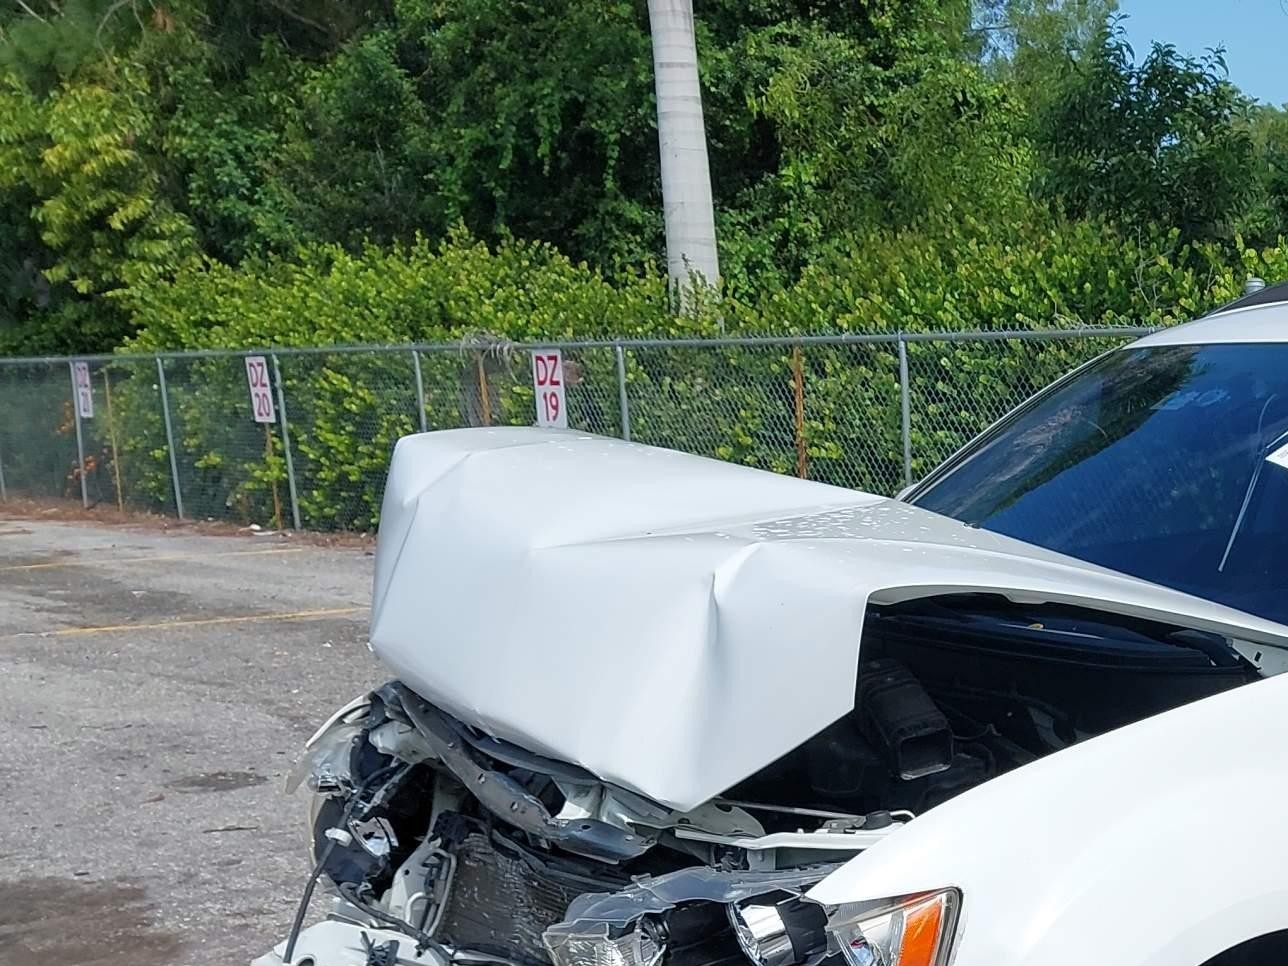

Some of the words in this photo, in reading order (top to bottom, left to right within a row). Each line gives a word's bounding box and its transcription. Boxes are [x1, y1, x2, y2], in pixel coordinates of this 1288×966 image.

[248, 362, 267, 388] DZ
[534, 355, 560, 386] DZ
[254, 392, 271, 417] 20
[543, 391, 559, 422] 19
